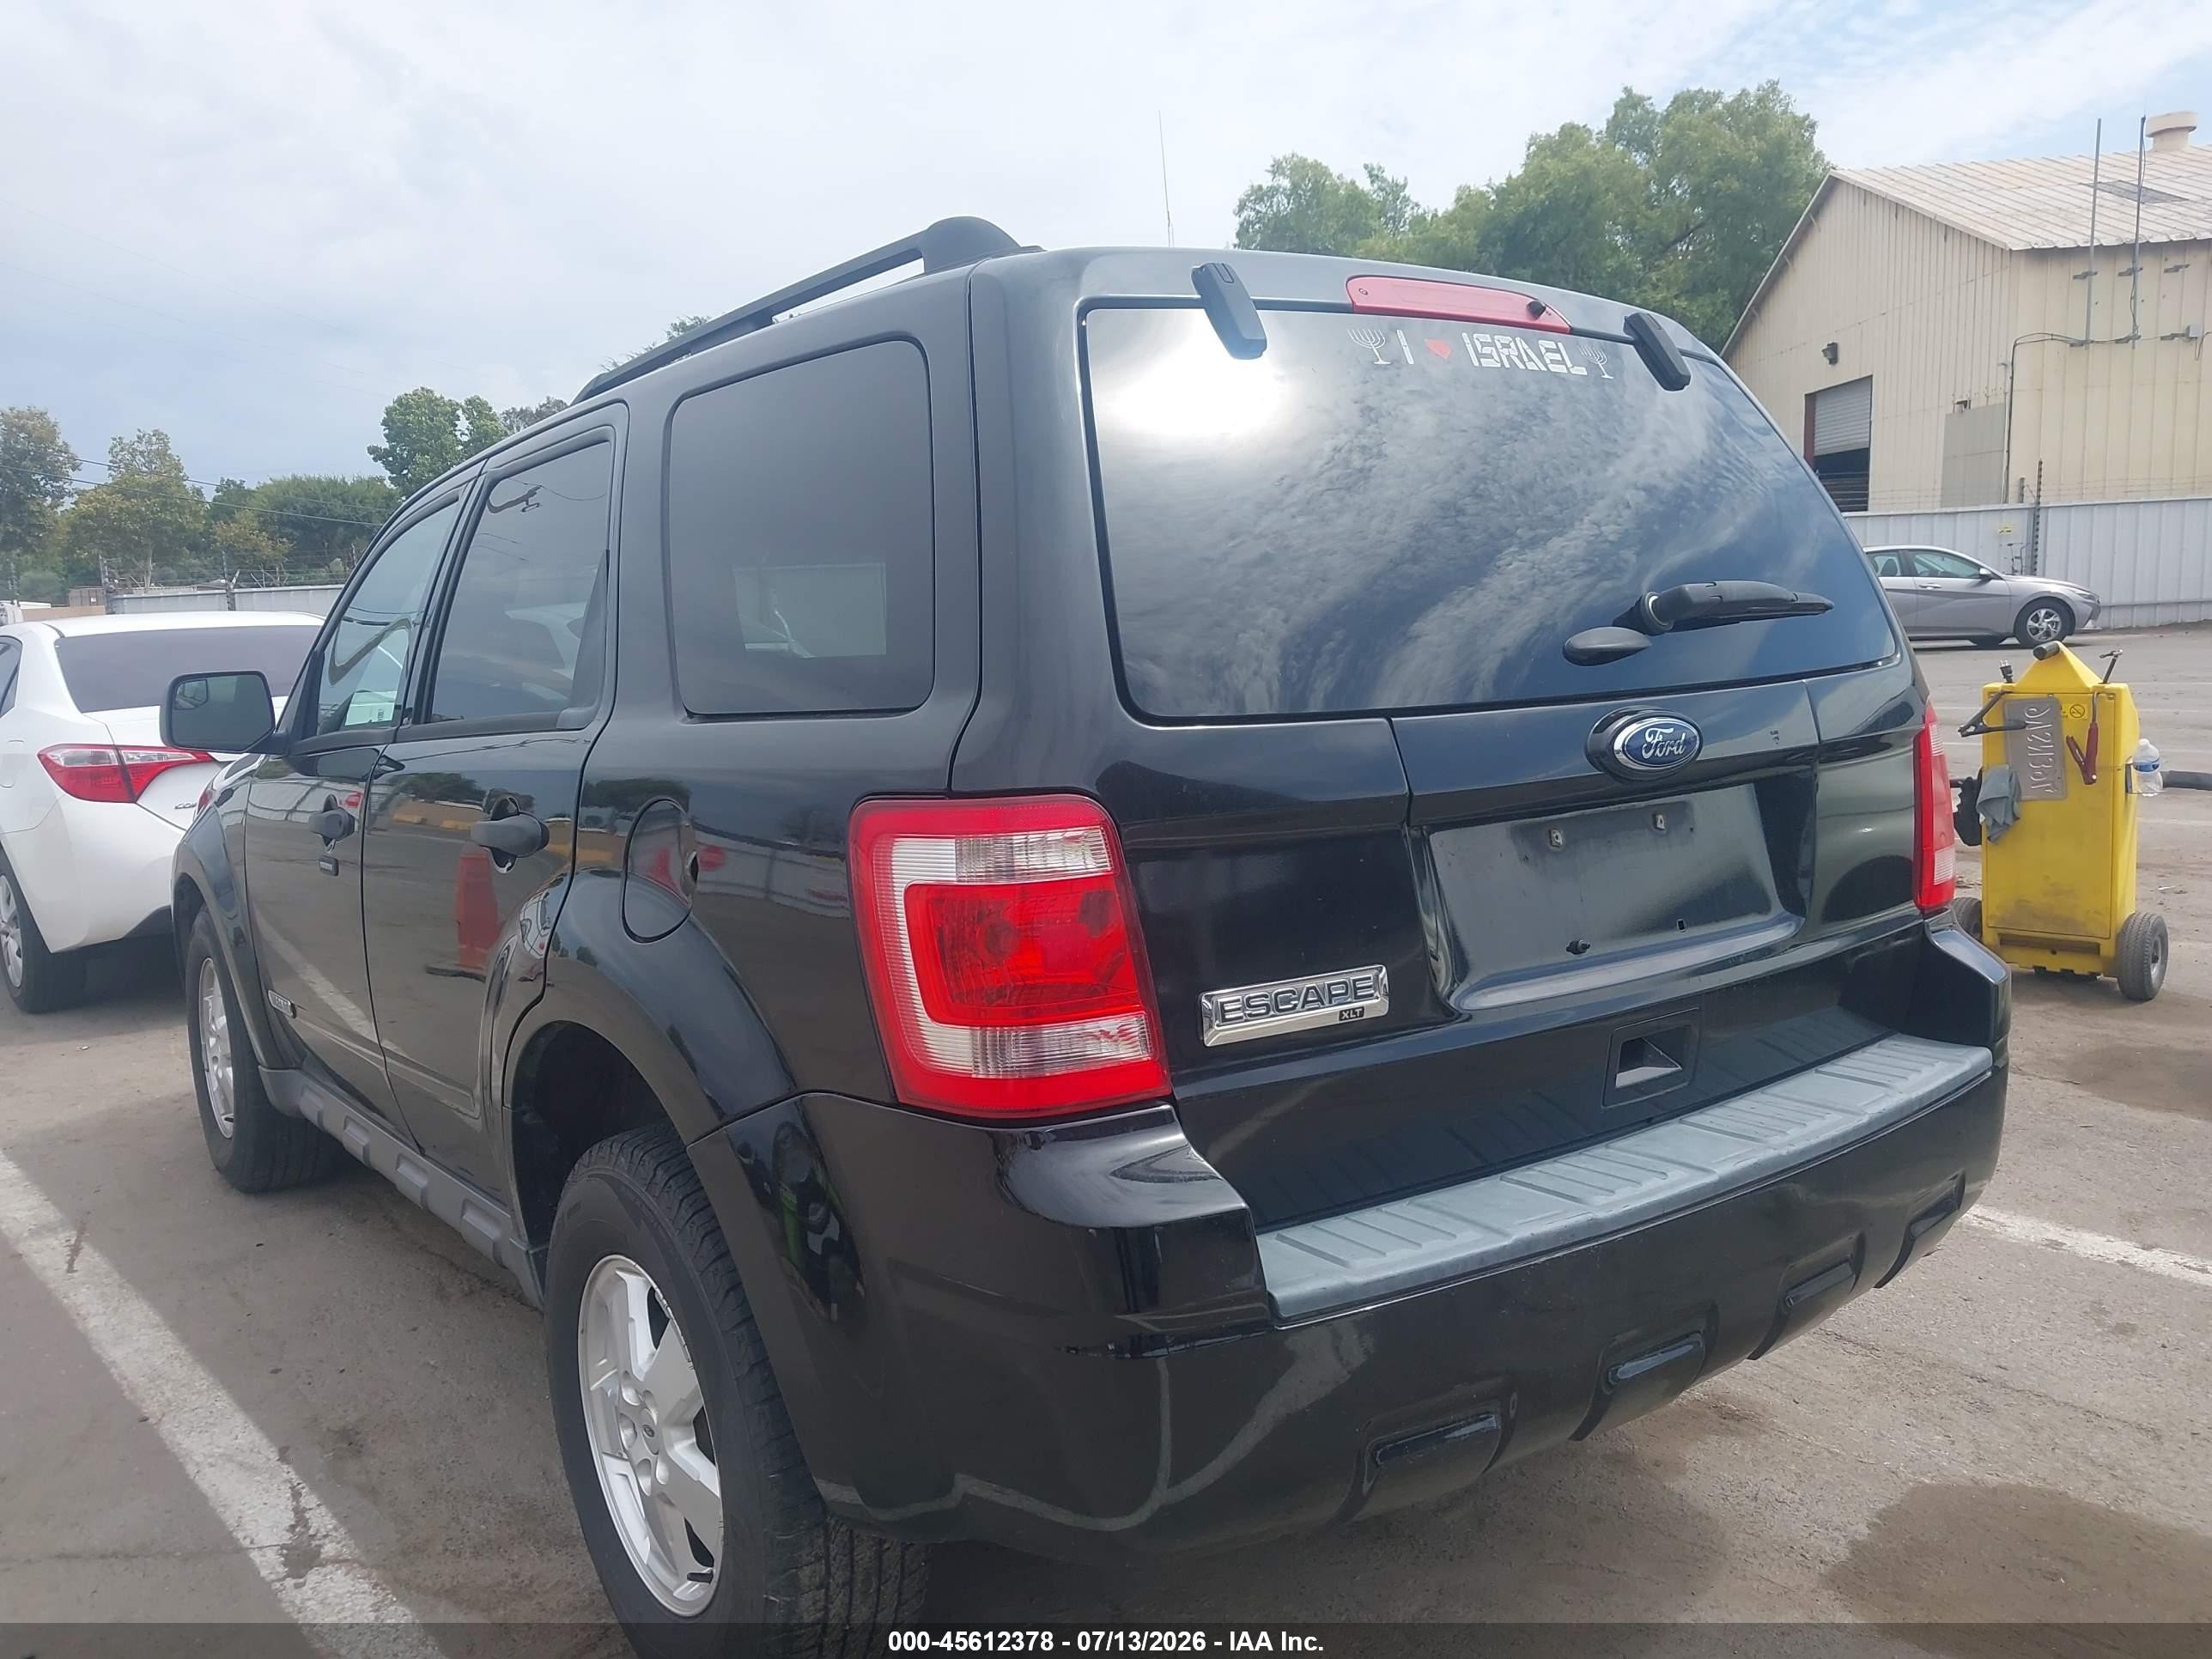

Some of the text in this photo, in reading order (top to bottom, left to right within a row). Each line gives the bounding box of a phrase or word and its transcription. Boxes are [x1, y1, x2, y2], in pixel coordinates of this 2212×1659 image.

[1396, 329, 1588, 375] I ISRAEL
[1641, 727, 1686, 759] Ford
[1218, 974, 1375, 1024] ESCAPE
[1340, 1007, 1364, 1019] XLT
